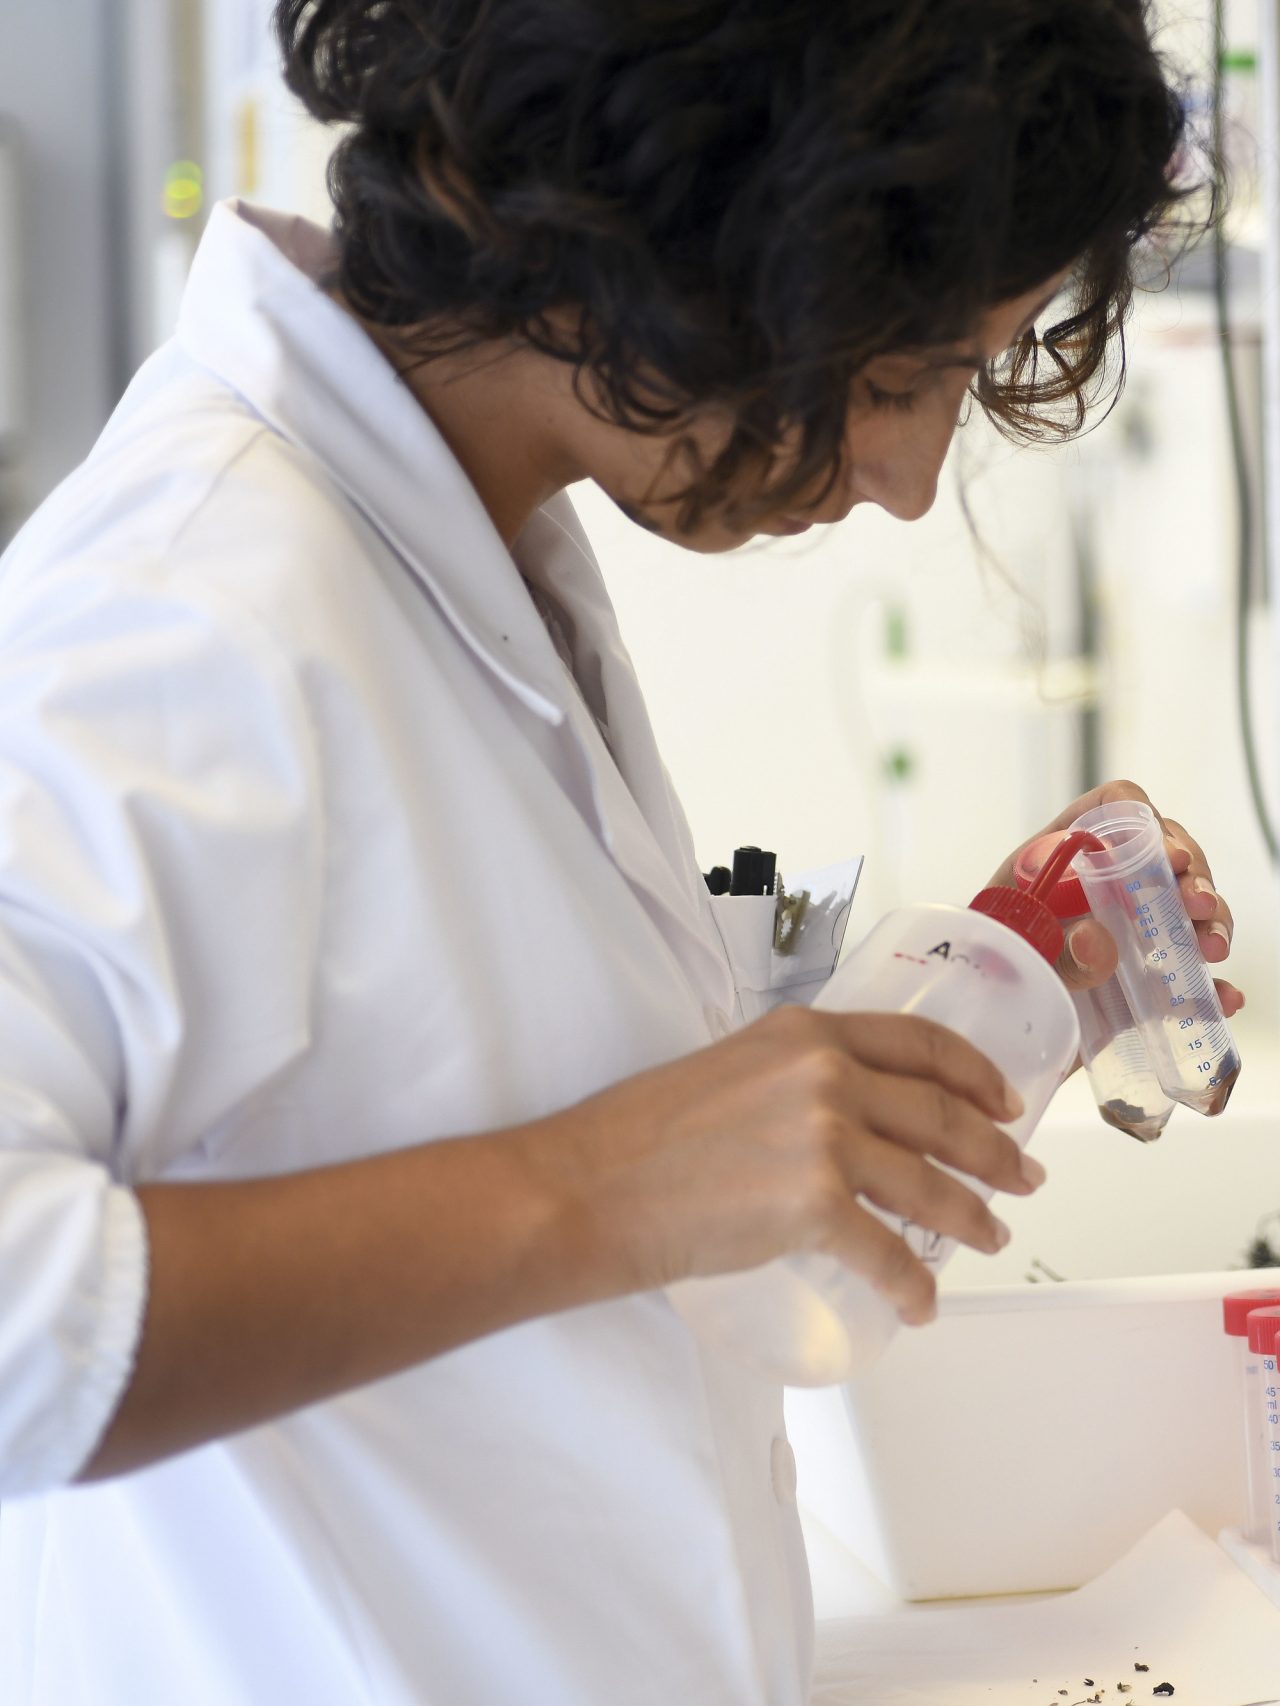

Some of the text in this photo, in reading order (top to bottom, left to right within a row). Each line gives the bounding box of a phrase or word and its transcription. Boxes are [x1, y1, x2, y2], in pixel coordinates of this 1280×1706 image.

[1145, 928, 1159, 939] 40
[1152, 950, 1168, 962] 35
[1161, 973, 1176, 985] 30
[1170, 995, 1185, 1007] 25
[1179, 1017, 1194, 1029] 20
[1188, 1039, 1203, 1051] 15
[1197, 1061, 1211, 1073] 10
[1264, 1360, 1274, 1370] 50
[1266, 1387, 1276, 1397] 45
[1268, 1414, 1279, 1424] 40
[1271, 1441, 1280, 1451] 35
